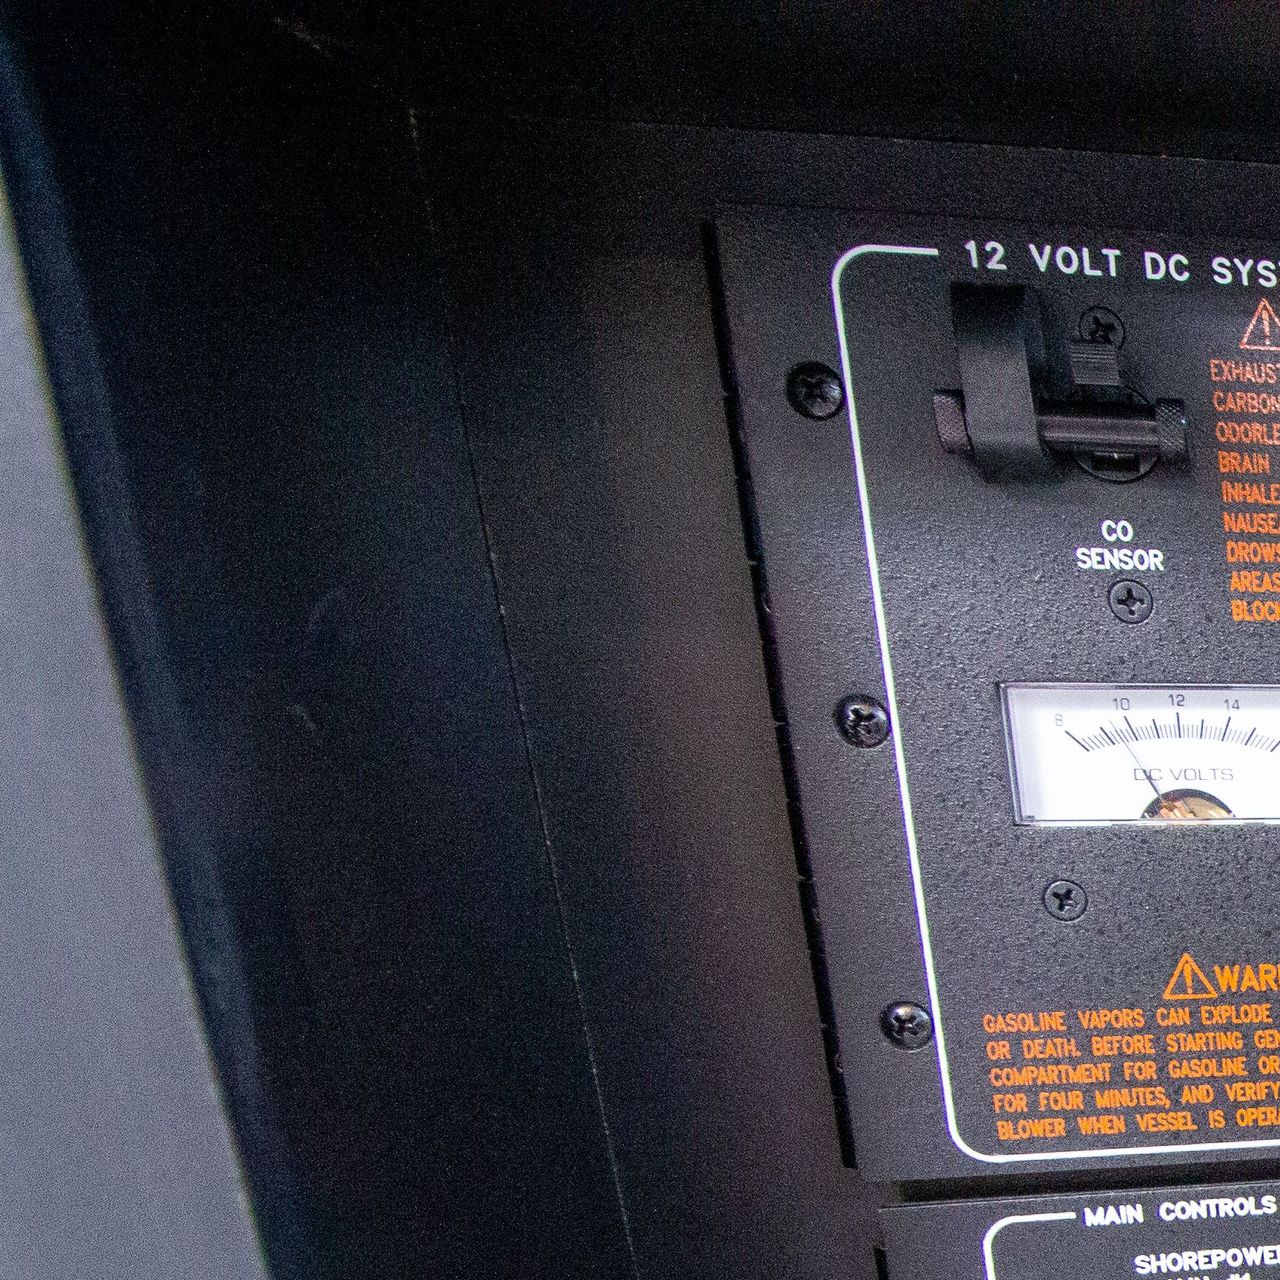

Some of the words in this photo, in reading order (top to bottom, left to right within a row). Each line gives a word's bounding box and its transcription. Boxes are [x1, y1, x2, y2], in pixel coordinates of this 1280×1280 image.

[965, 240, 1007, 270] 12
[1029, 244, 1120, 276] VOLT
[1145, 252, 1189, 281] DC
[1101, 519, 1133, 542] CO
[1076, 547, 1164, 570] SENSOR
[1113, 698, 1131, 711] 10
[1168, 694, 1186, 707] 12
[1223, 698, 1240, 711] 14
[1054, 713, 1064, 727] 8
[1133, 768, 1162, 781] DC
[1169, 767, 1234, 782] VOLTS
[984, 1011, 1065, 1032] GASOLINE
[1078, 1008, 1144, 1028] VAPORS
[1156, 1007, 1190, 1027] CAN
[1200, 1003, 1272, 1025] EXPLODE
[987, 1041, 1010, 1059] OR
[1091, 1034, 1154, 1056] BEFORE
[1165, 1031, 1243, 1052] STARTING
[998, 1118, 1065, 1139] BLOWER
[1078, 1115, 1125, 1134] WHEN
[1137, 1111, 1196, 1131] VESSEL
[1208, 1110, 1225, 1128] IS
[1084, 1204, 1144, 1226] MAIN
[1160, 1195, 1277, 1220] CONTROLS
